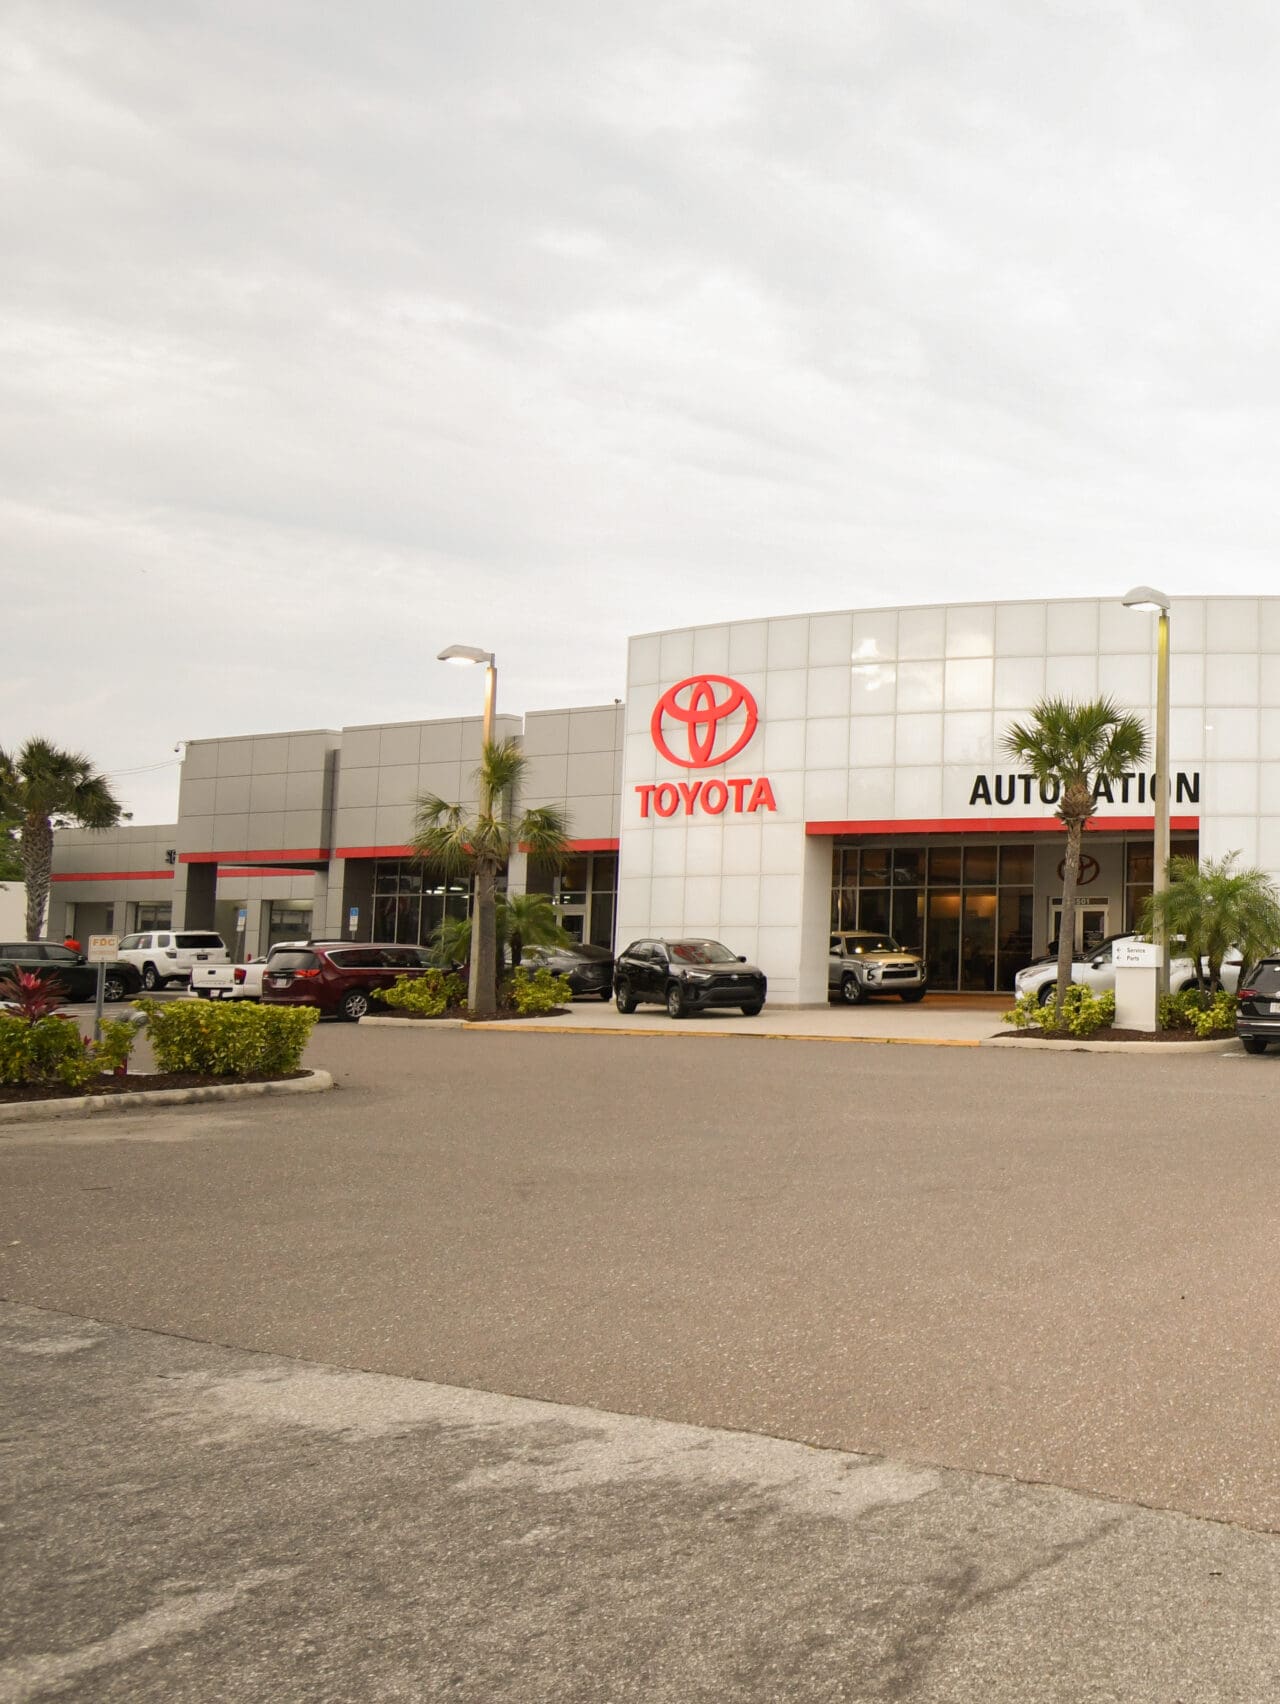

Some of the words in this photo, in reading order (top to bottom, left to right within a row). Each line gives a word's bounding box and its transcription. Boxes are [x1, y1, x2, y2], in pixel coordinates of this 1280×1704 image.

[635, 777, 777, 818] TOYOTA
[969, 771, 1200, 805] AUTOATIN
[92, 937, 116, 946] FDC
